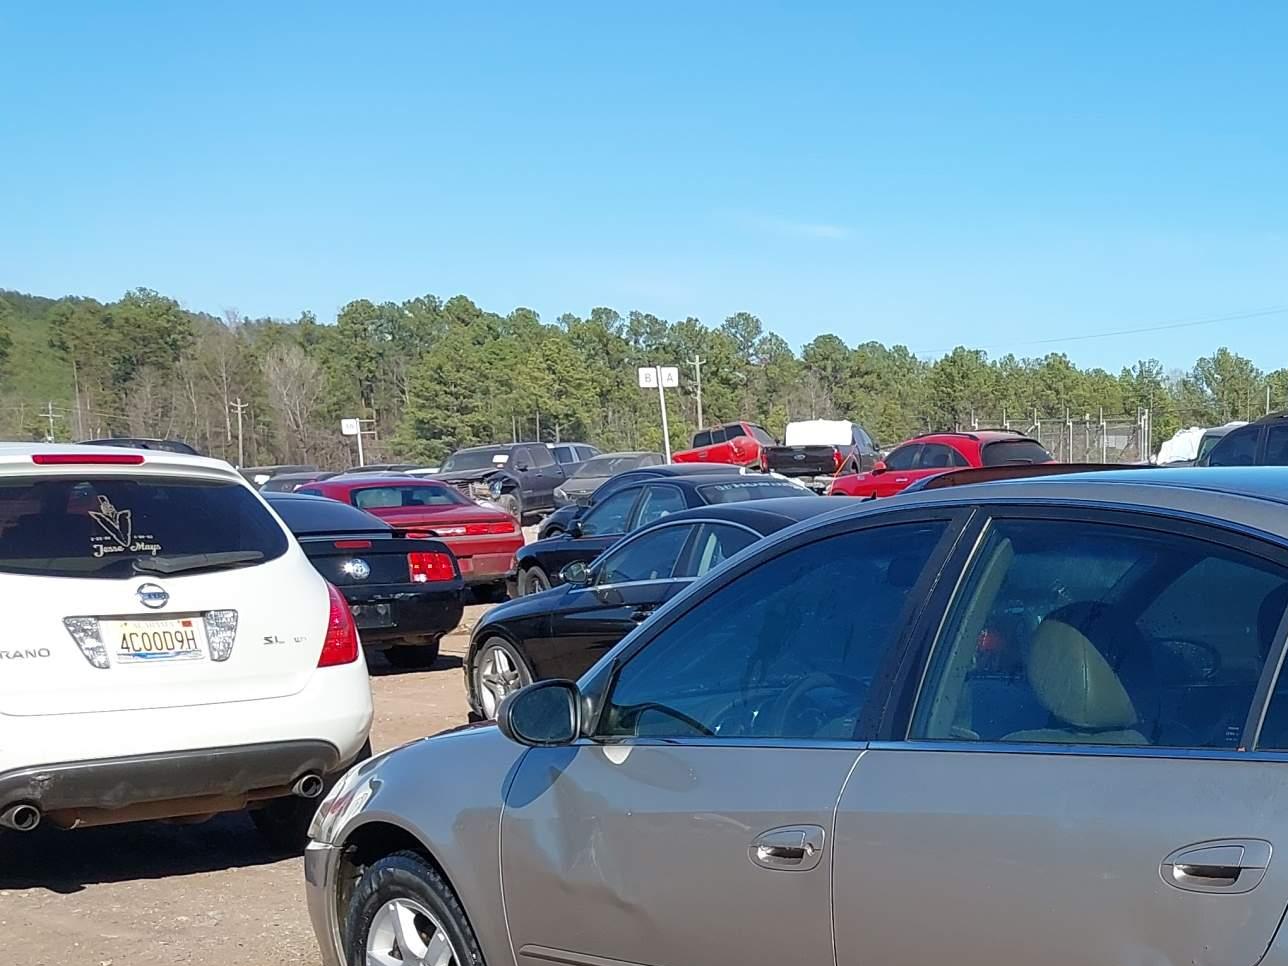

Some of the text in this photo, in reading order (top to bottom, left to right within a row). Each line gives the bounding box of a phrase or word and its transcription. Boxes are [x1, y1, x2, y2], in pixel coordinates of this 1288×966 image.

[644, 373, 652, 383] B
[666, 373, 674, 383] A
[263, 635, 286, 645] SL
